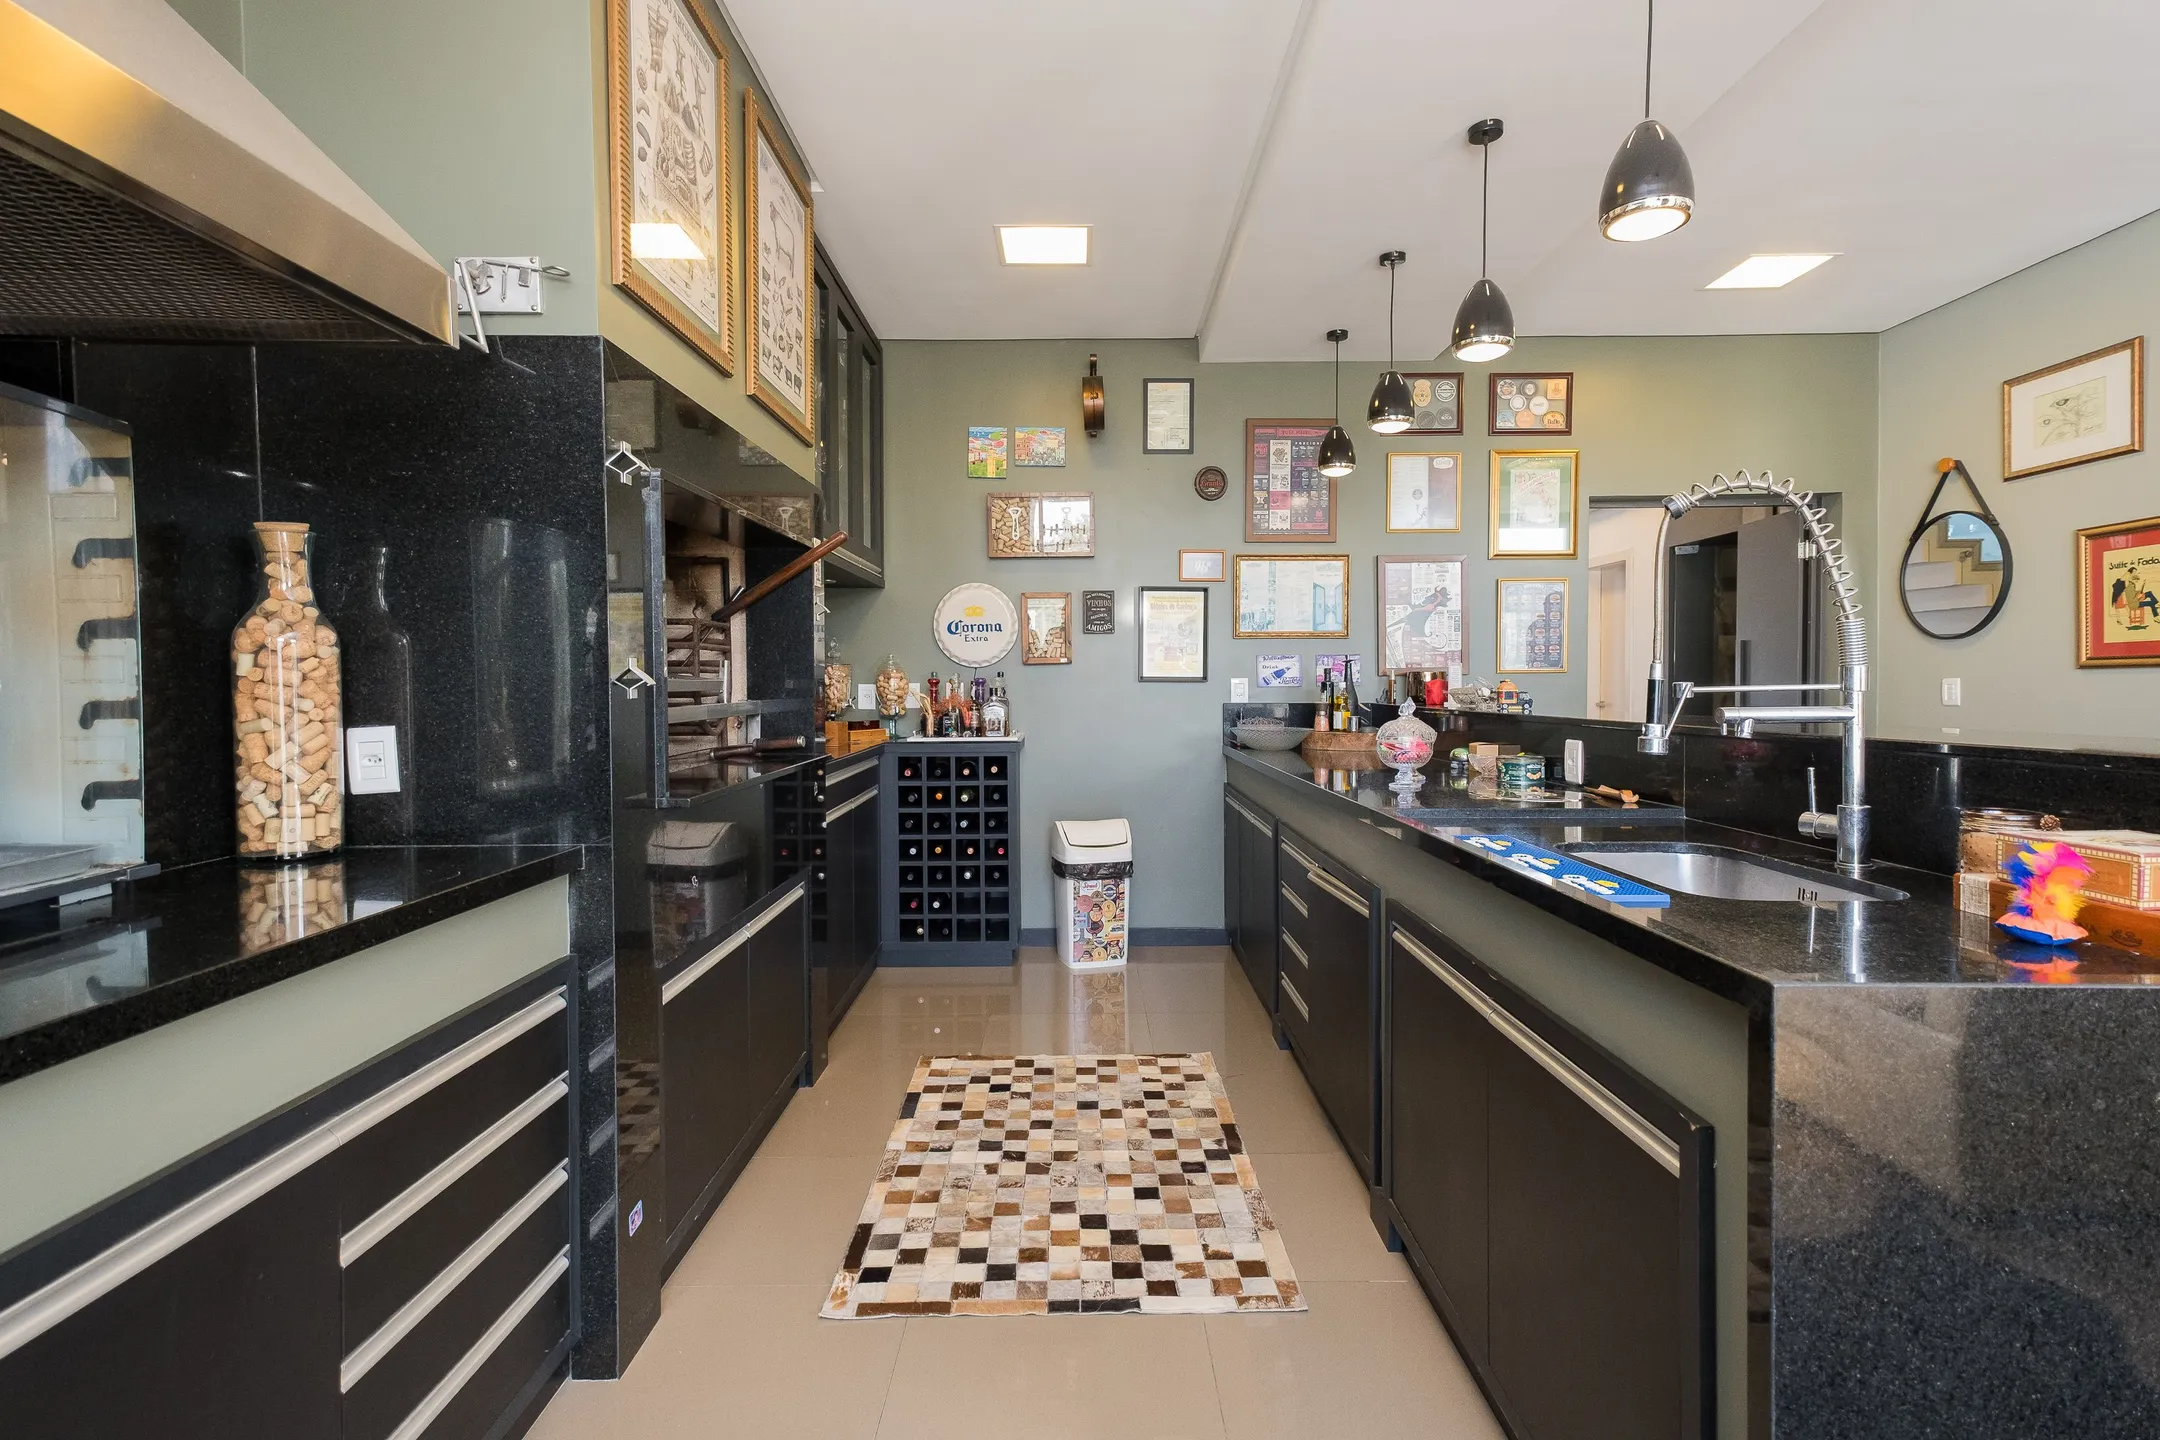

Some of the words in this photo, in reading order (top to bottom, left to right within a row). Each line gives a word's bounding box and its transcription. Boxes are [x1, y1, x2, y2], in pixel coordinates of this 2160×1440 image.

[673, 9, 710, 73] ARGENTINO
[2137, 556, 2160, 566] Fado
[947, 620, 1002, 636] Corona
[1086, 622, 1113, 631] AMIGOS
[964, 634, 988, 642] Extra
